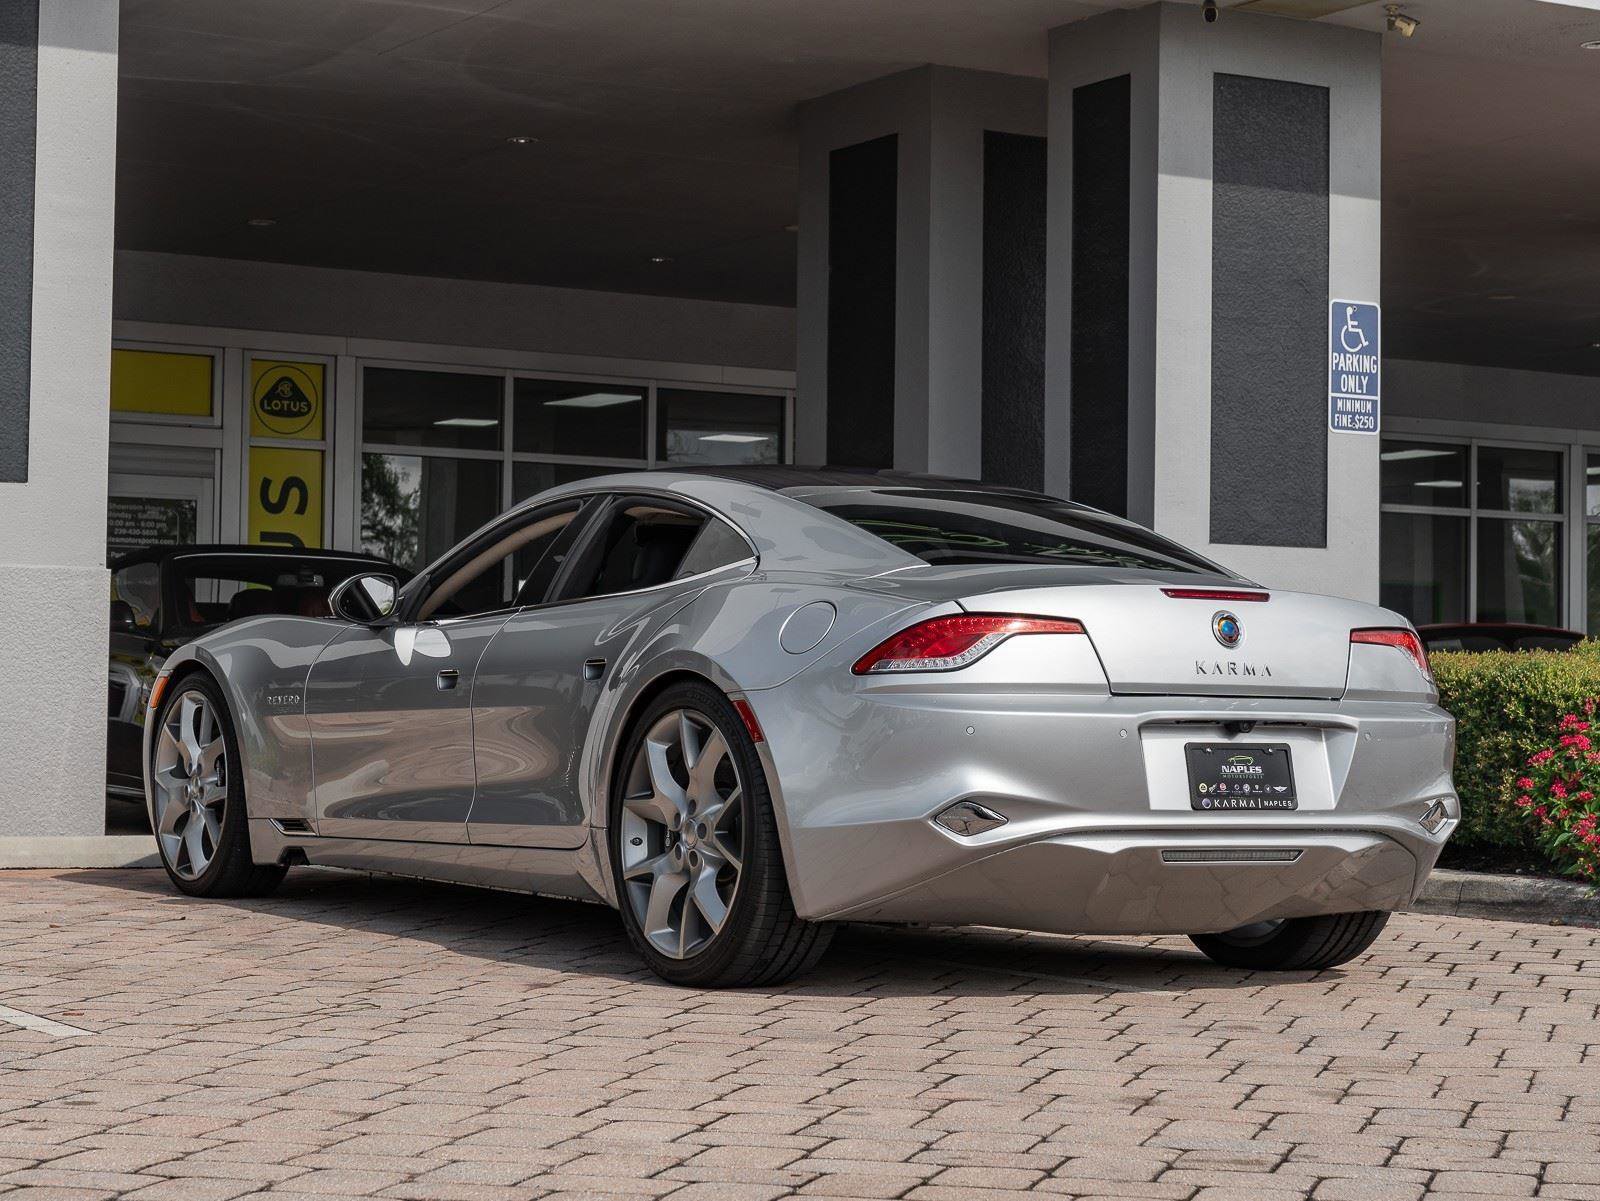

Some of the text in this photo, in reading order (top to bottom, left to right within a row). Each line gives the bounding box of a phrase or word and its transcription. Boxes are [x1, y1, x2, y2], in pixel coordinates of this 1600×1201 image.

[1332, 352, 1377, 373] PARKING
[1340, 374, 1368, 393] ONLY
[263, 399, 308, 412] LOTUS
[1337, 399, 1372, 413] MINIMUM
[1354, 414, 1375, 429] $250
[1195, 660, 1272, 677] KARMA
[266, 695, 300, 705] REVERO
[1221, 765, 1262, 774] NAPLES
[1214, 799, 1256, 808] KARMA
